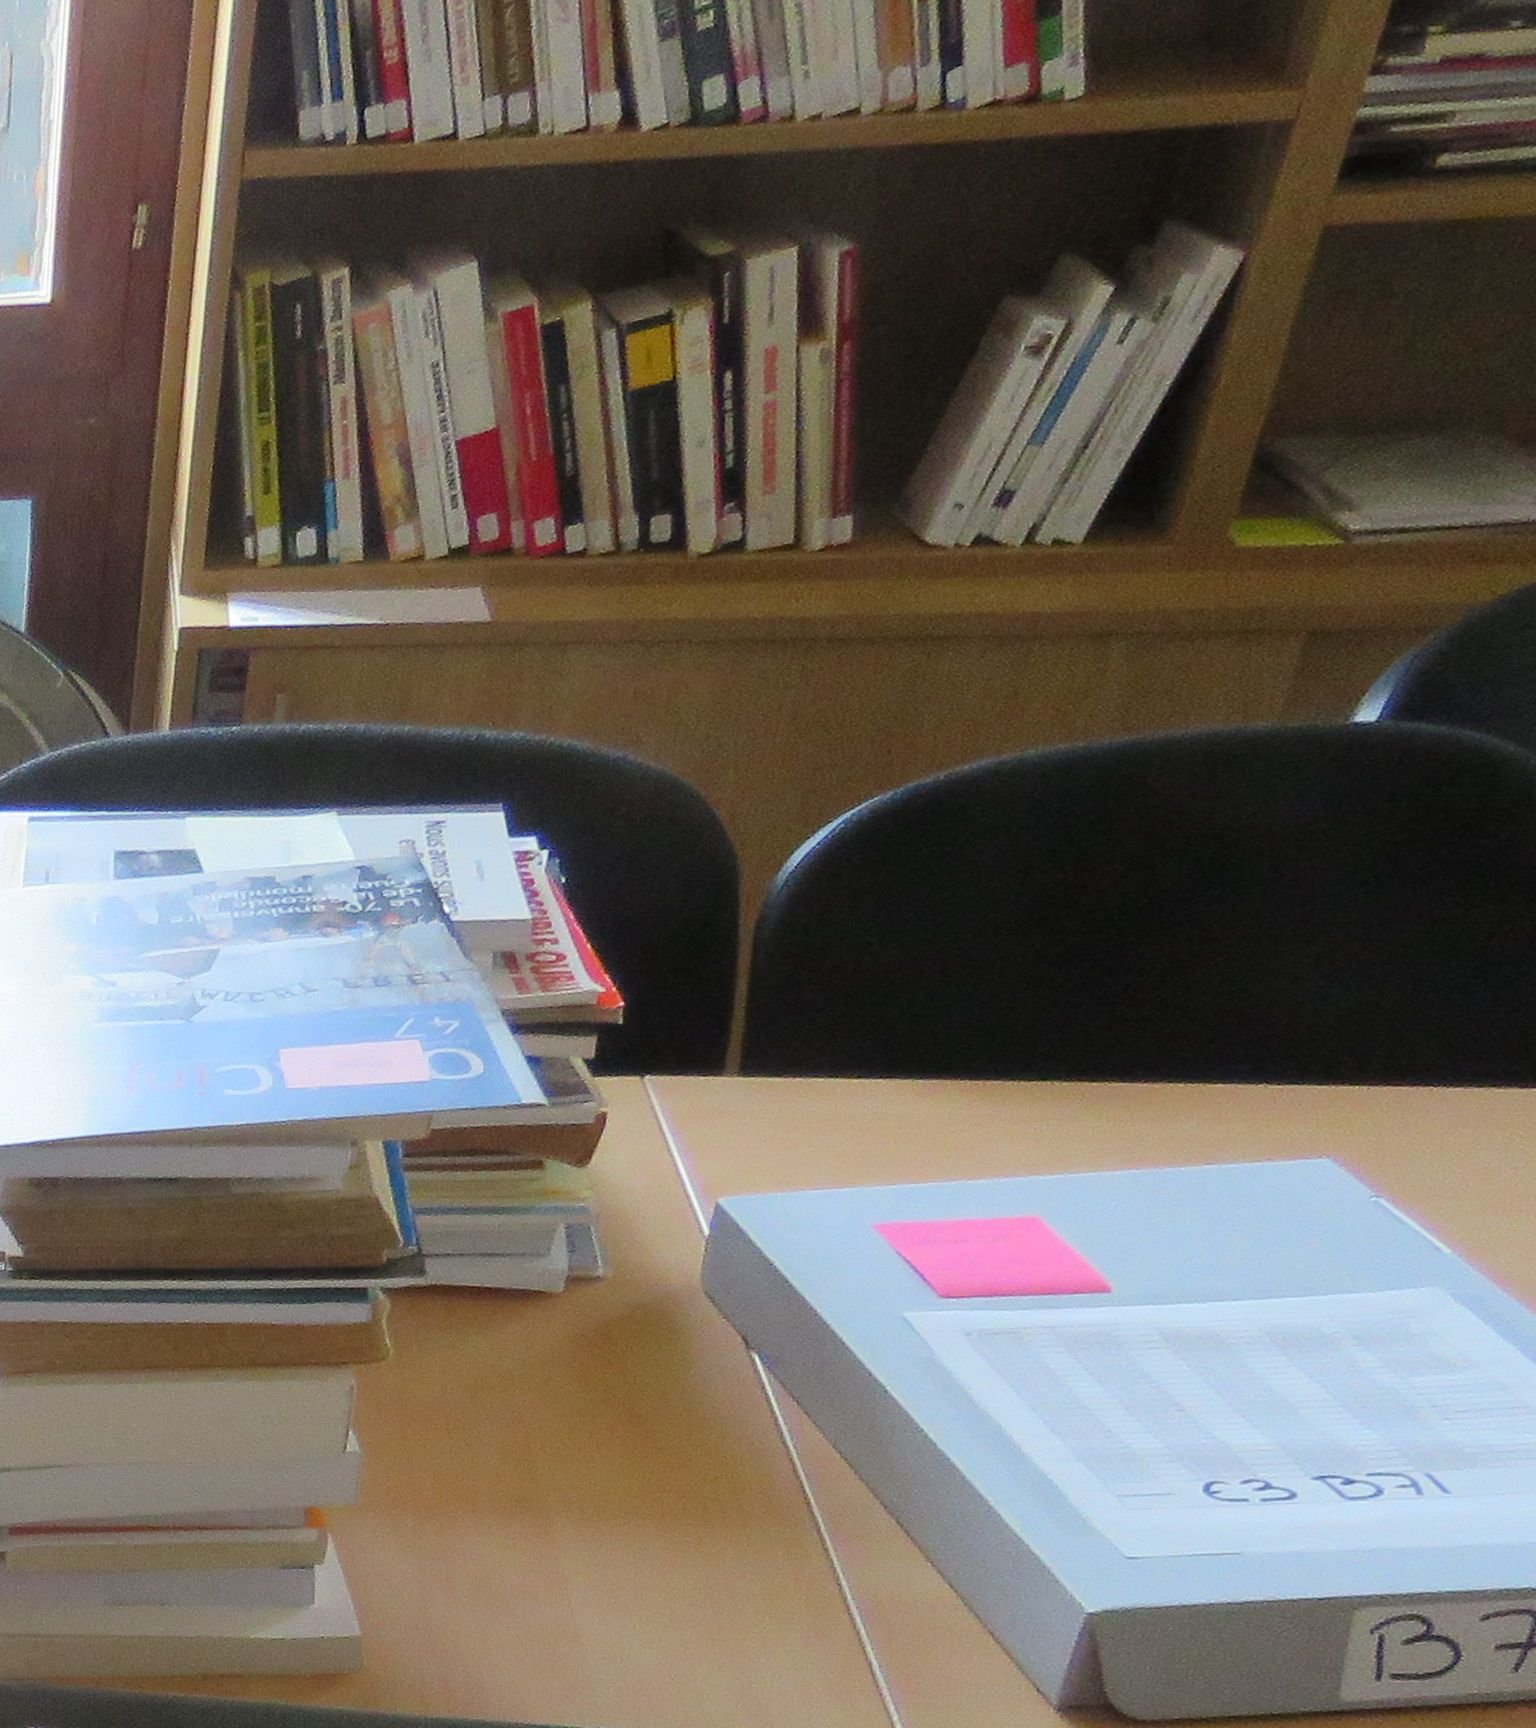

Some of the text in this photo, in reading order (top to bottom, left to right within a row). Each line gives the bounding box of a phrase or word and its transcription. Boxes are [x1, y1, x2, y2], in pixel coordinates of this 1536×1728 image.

[424, 819, 447, 847] Nous
[428, 849, 451, 879] avons
[393, 1014, 461, 1039] 47
[1312, 1472, 1454, 1502] B71
